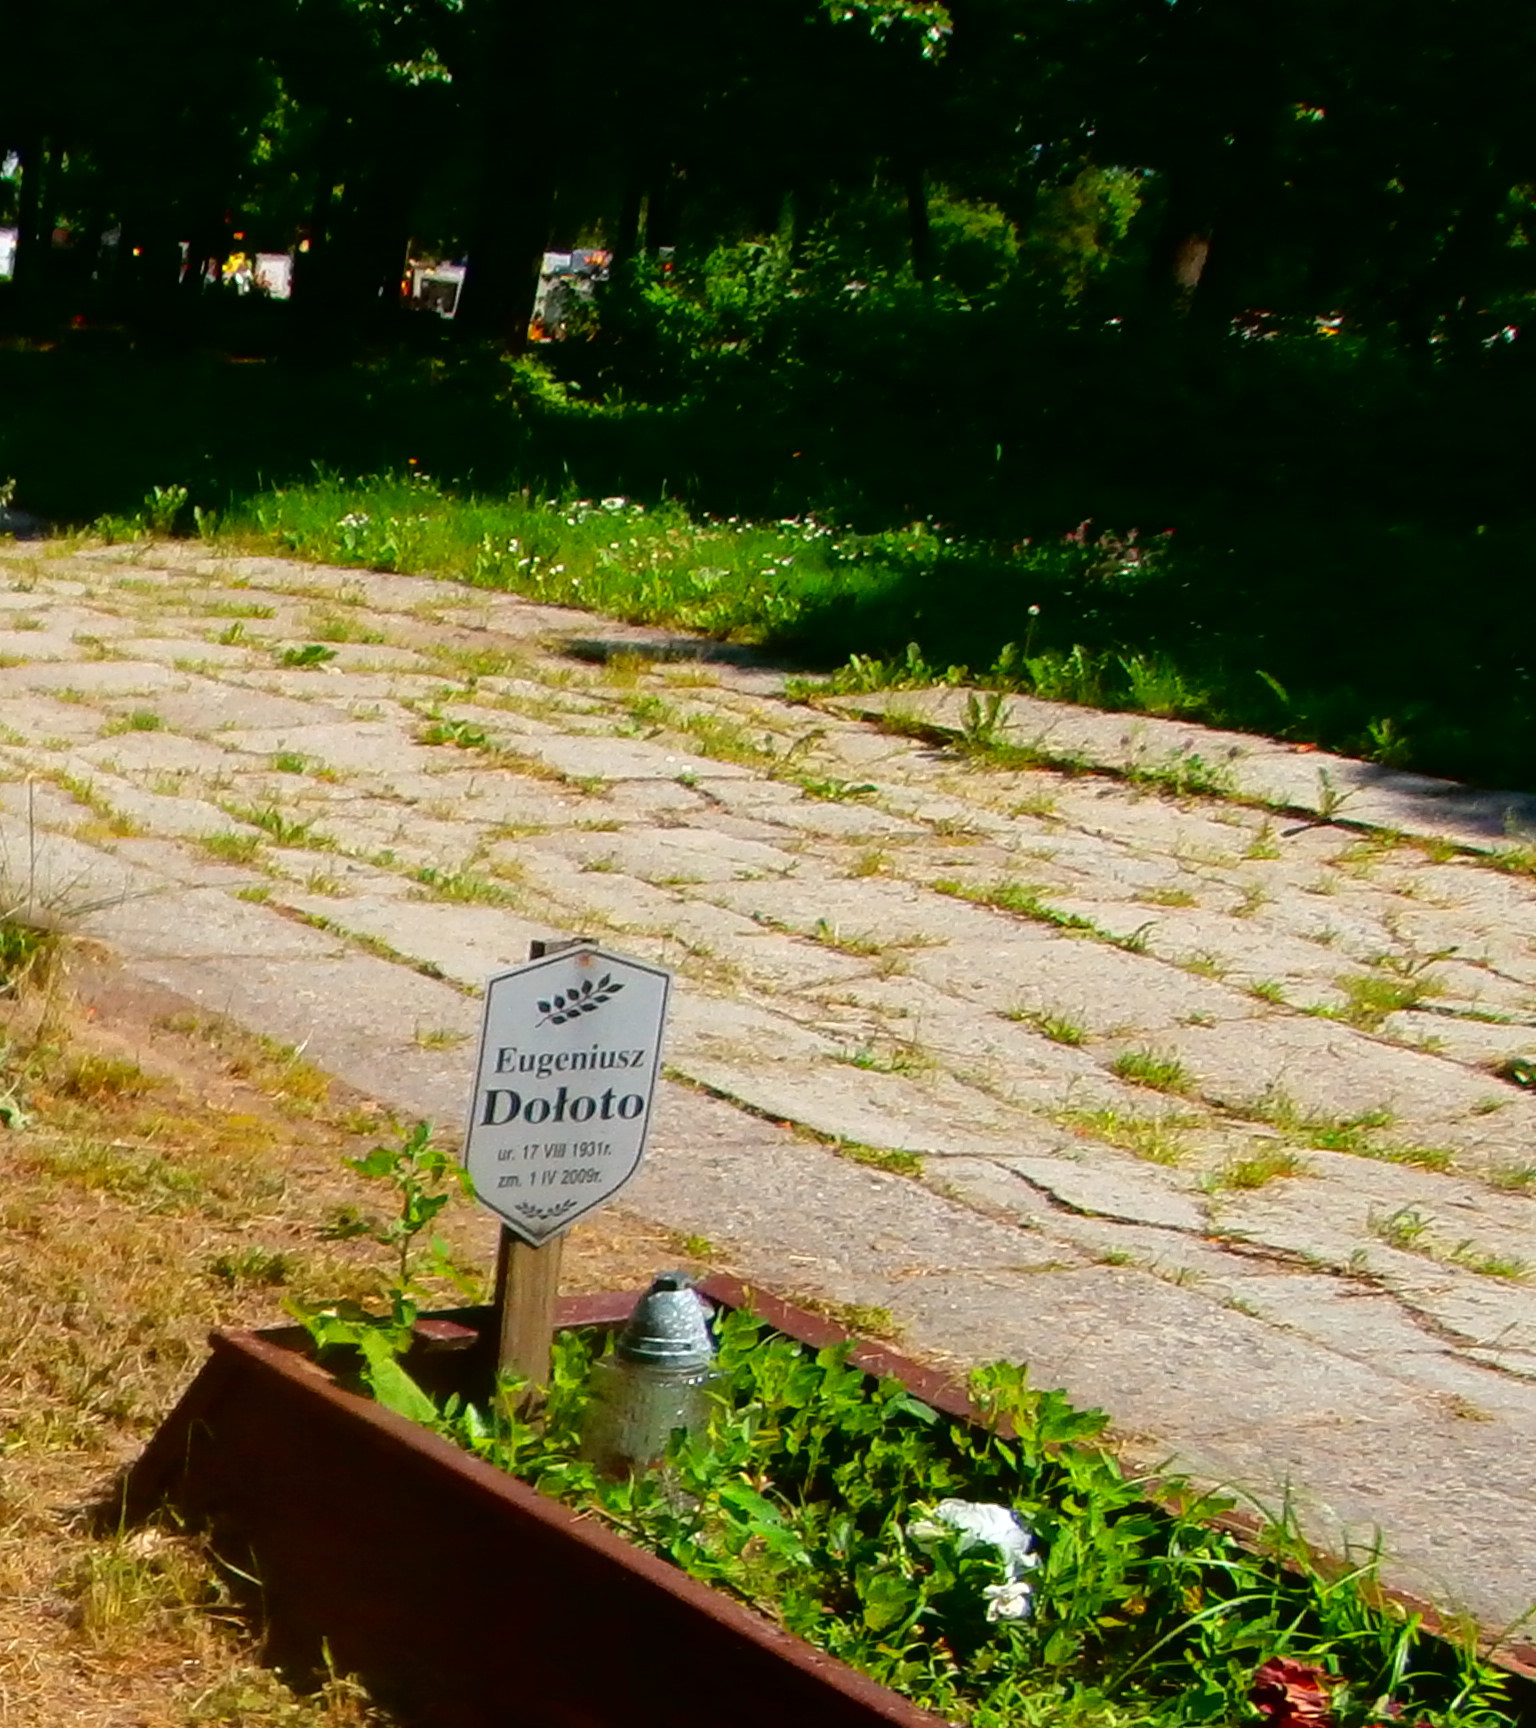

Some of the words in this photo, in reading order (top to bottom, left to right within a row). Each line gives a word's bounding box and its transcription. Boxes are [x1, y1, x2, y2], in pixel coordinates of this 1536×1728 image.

[494, 1043, 645, 1079] Eugeniusz
[479, 1086, 645, 1127] Dołoto
[497, 1149, 515, 1161] ur.
[523, 1144, 539, 1160] 17
[543, 1142, 567, 1158] VIII
[496, 1174, 522, 1189] zm.
[530, 1170, 537, 1187] 1
[541, 1169, 558, 1185] IV
[560, 1167, 603, 1185] 2009r.
